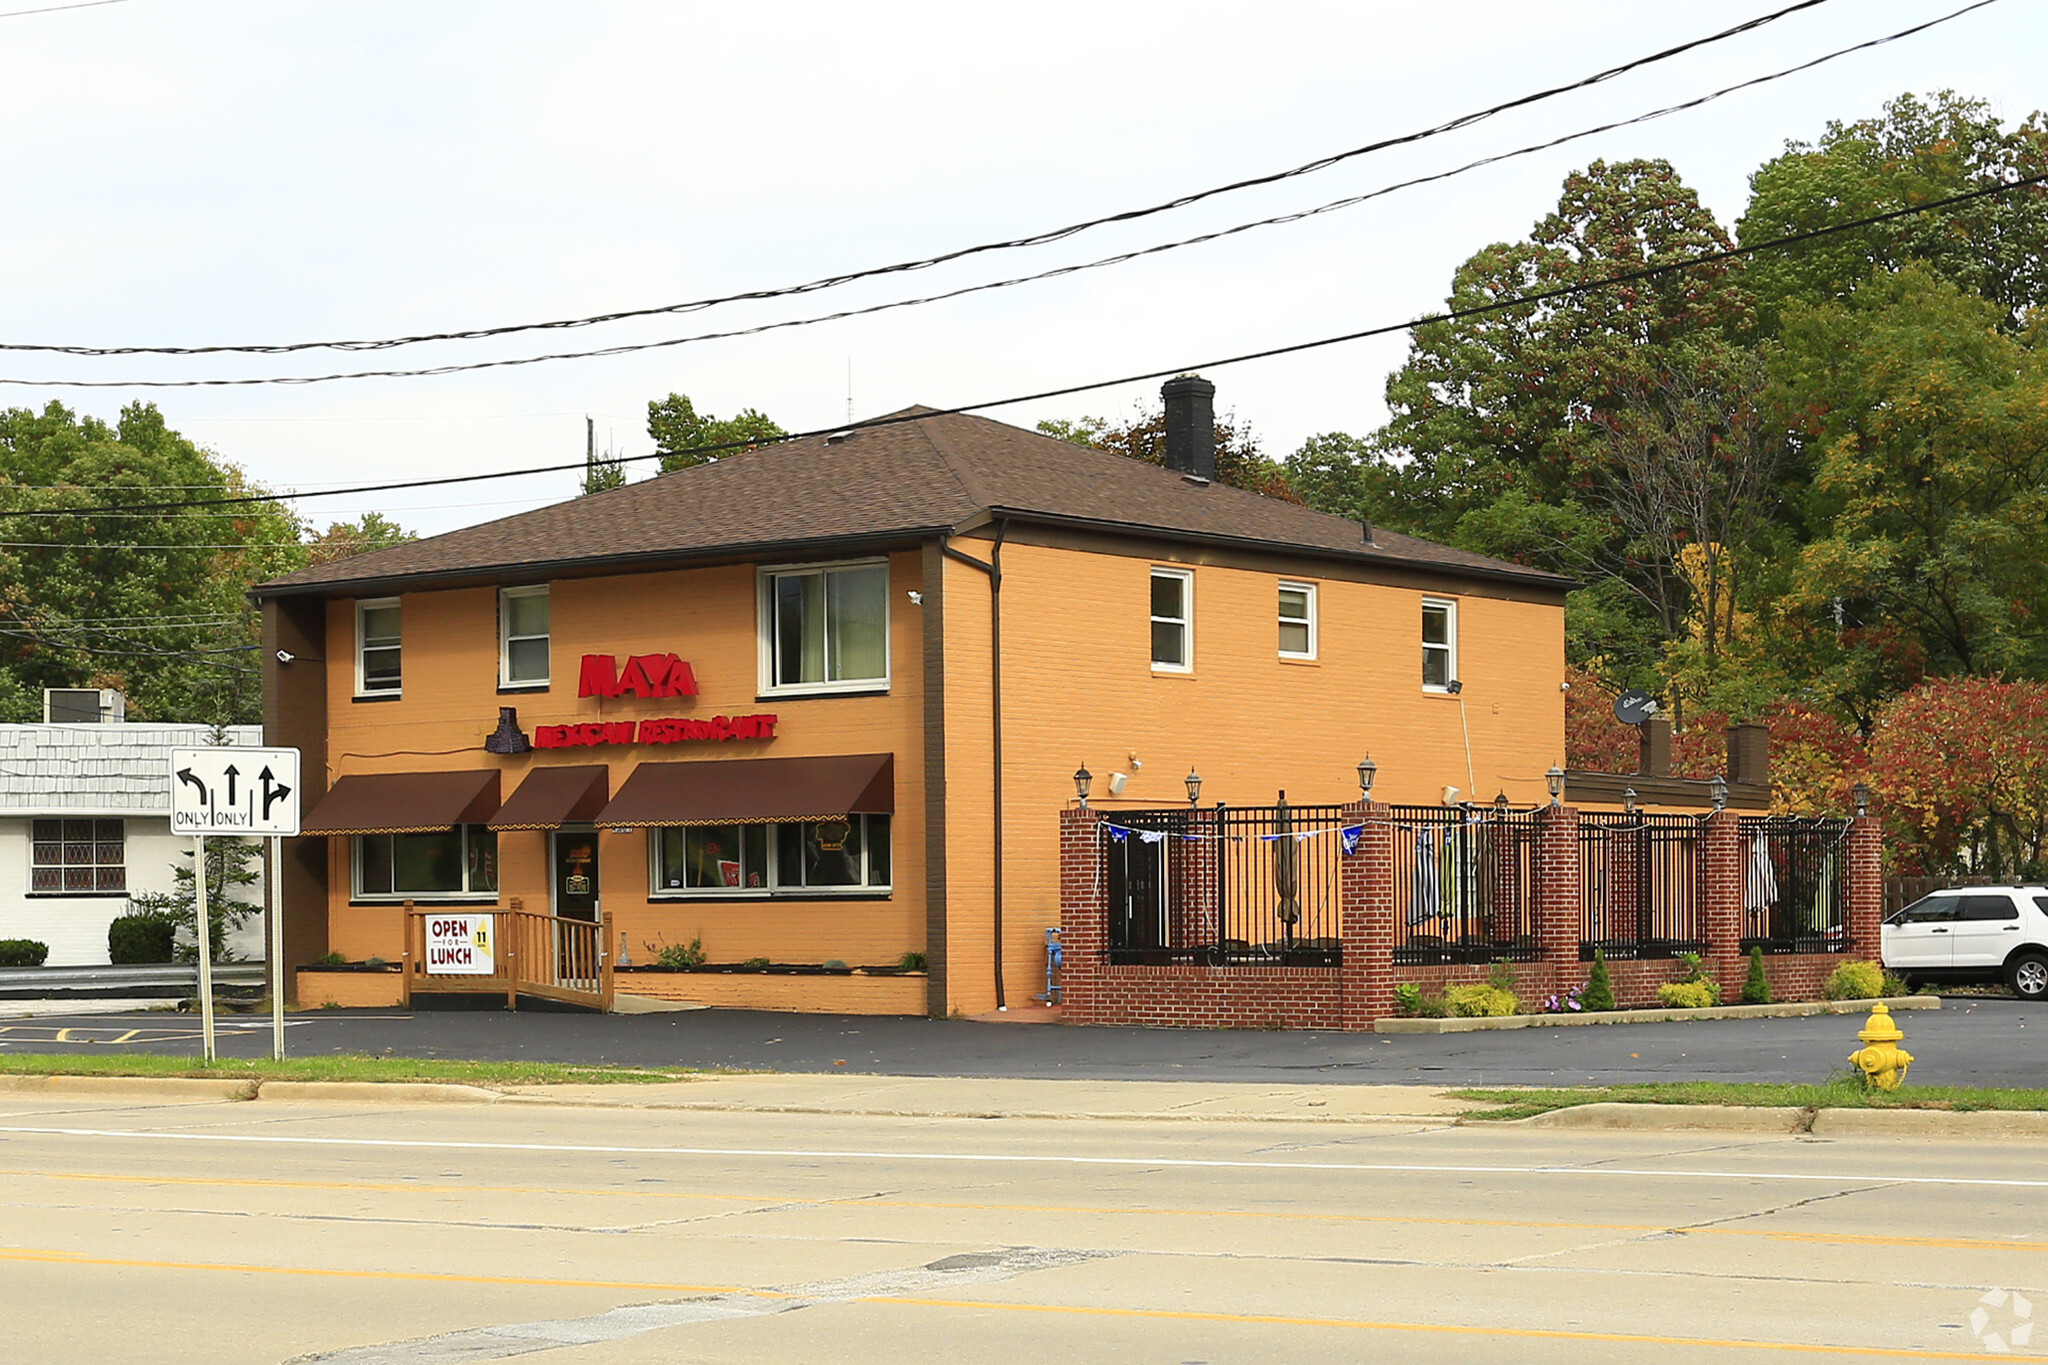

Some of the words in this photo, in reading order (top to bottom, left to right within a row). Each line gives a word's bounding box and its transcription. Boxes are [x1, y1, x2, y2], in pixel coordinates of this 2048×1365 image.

[578, 653, 699, 698] MAYA
[534, 721, 636, 748] MEXICAN
[176, 811, 209, 825] ONLY
[216, 811, 247, 825] ONLY
[432, 920, 468, 937] OPEN
[476, 931, 486, 943] 11
[431, 948, 472, 964] LUNCH
